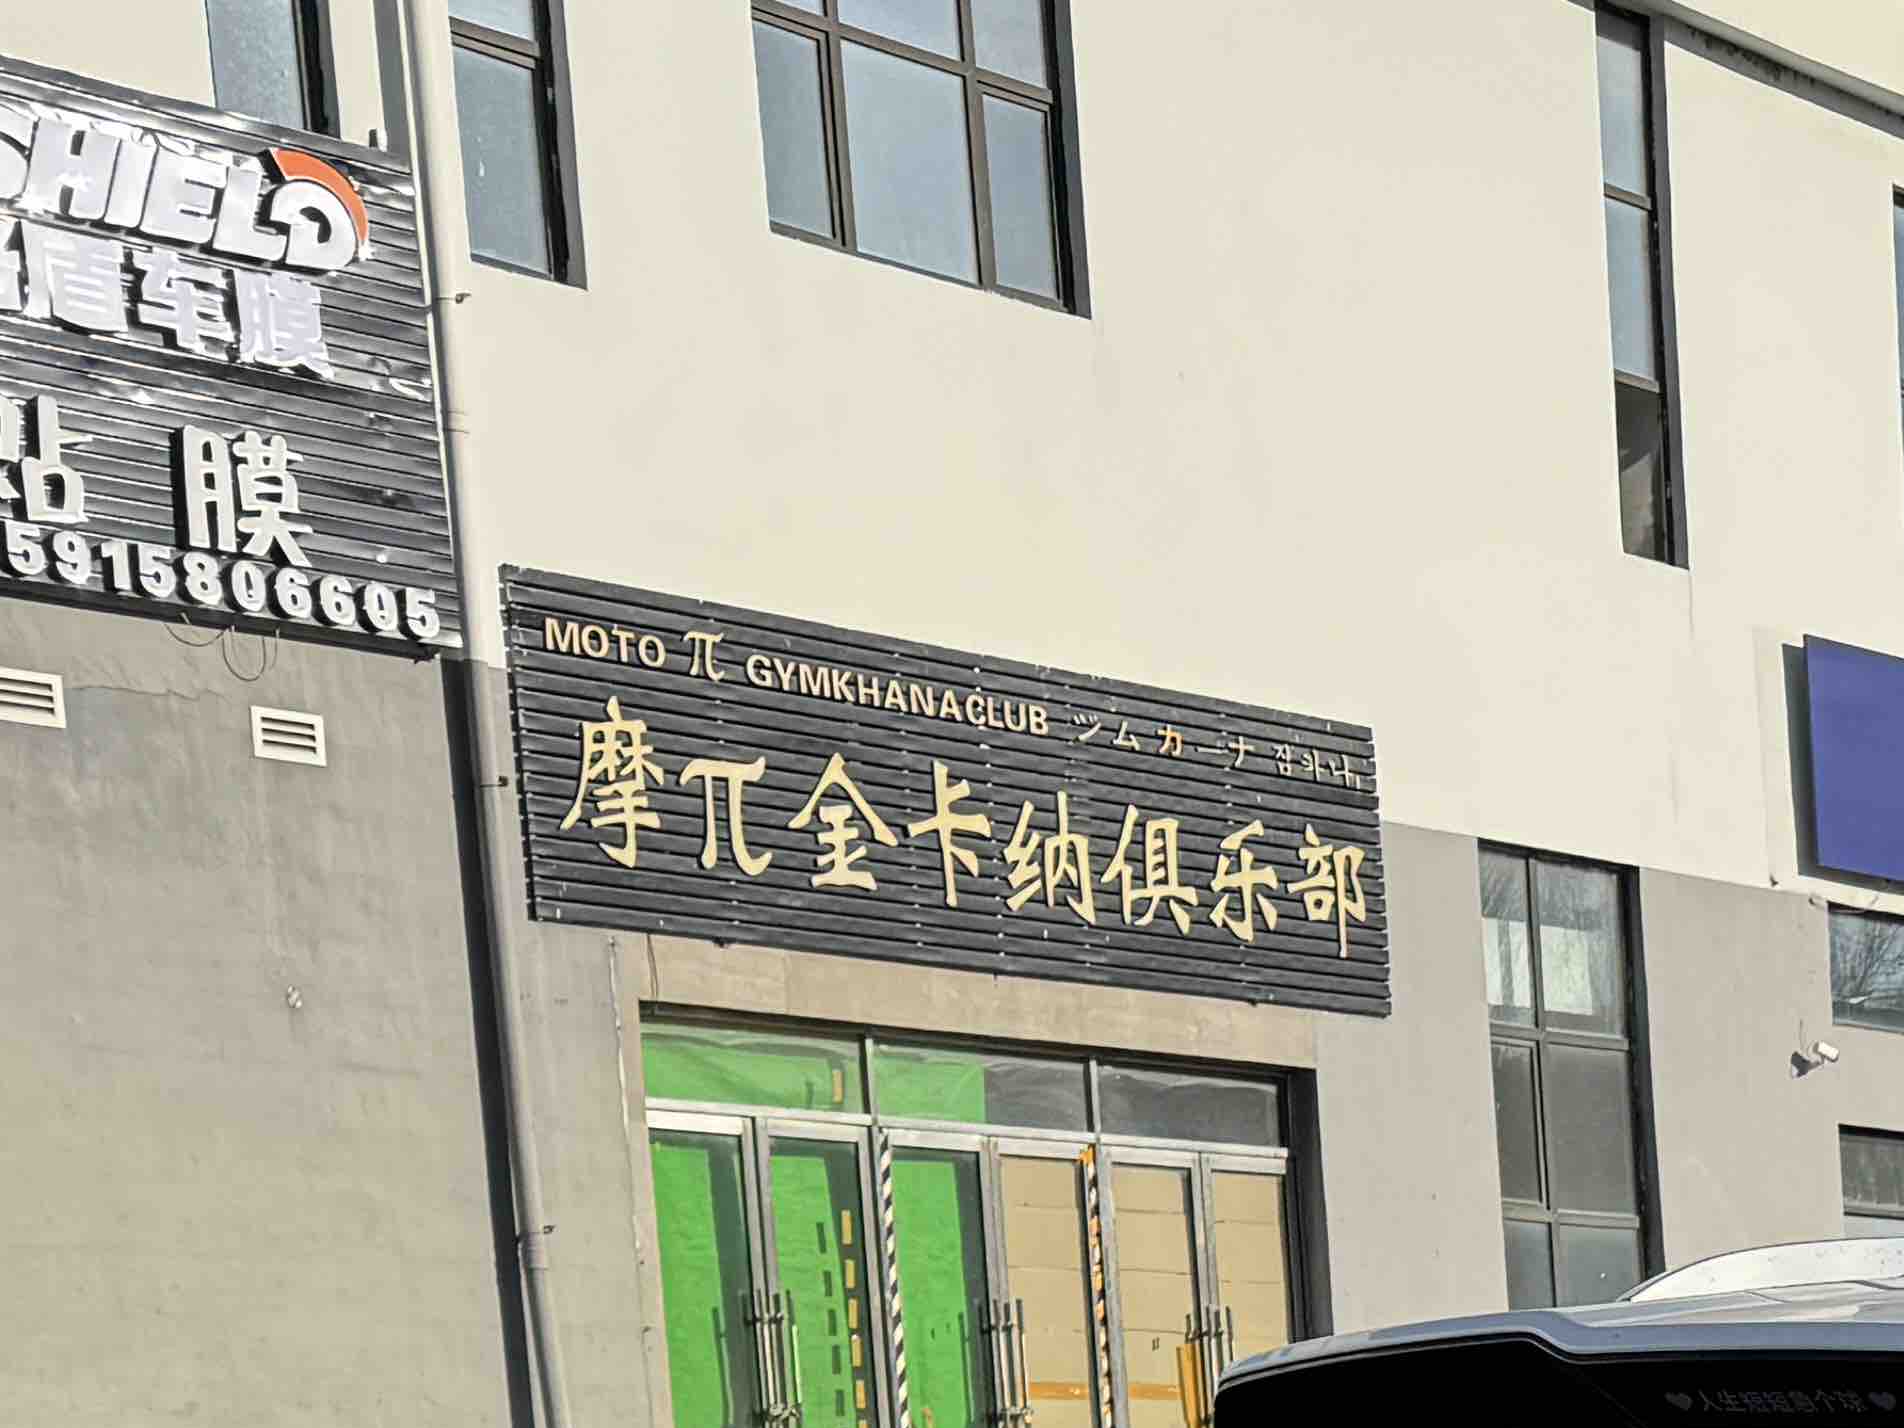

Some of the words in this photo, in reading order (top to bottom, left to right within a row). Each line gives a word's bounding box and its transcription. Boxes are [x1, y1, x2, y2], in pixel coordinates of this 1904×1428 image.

[0, 215, 335, 380] 盾车膜
[544, 617, 666, 668] MOTO
